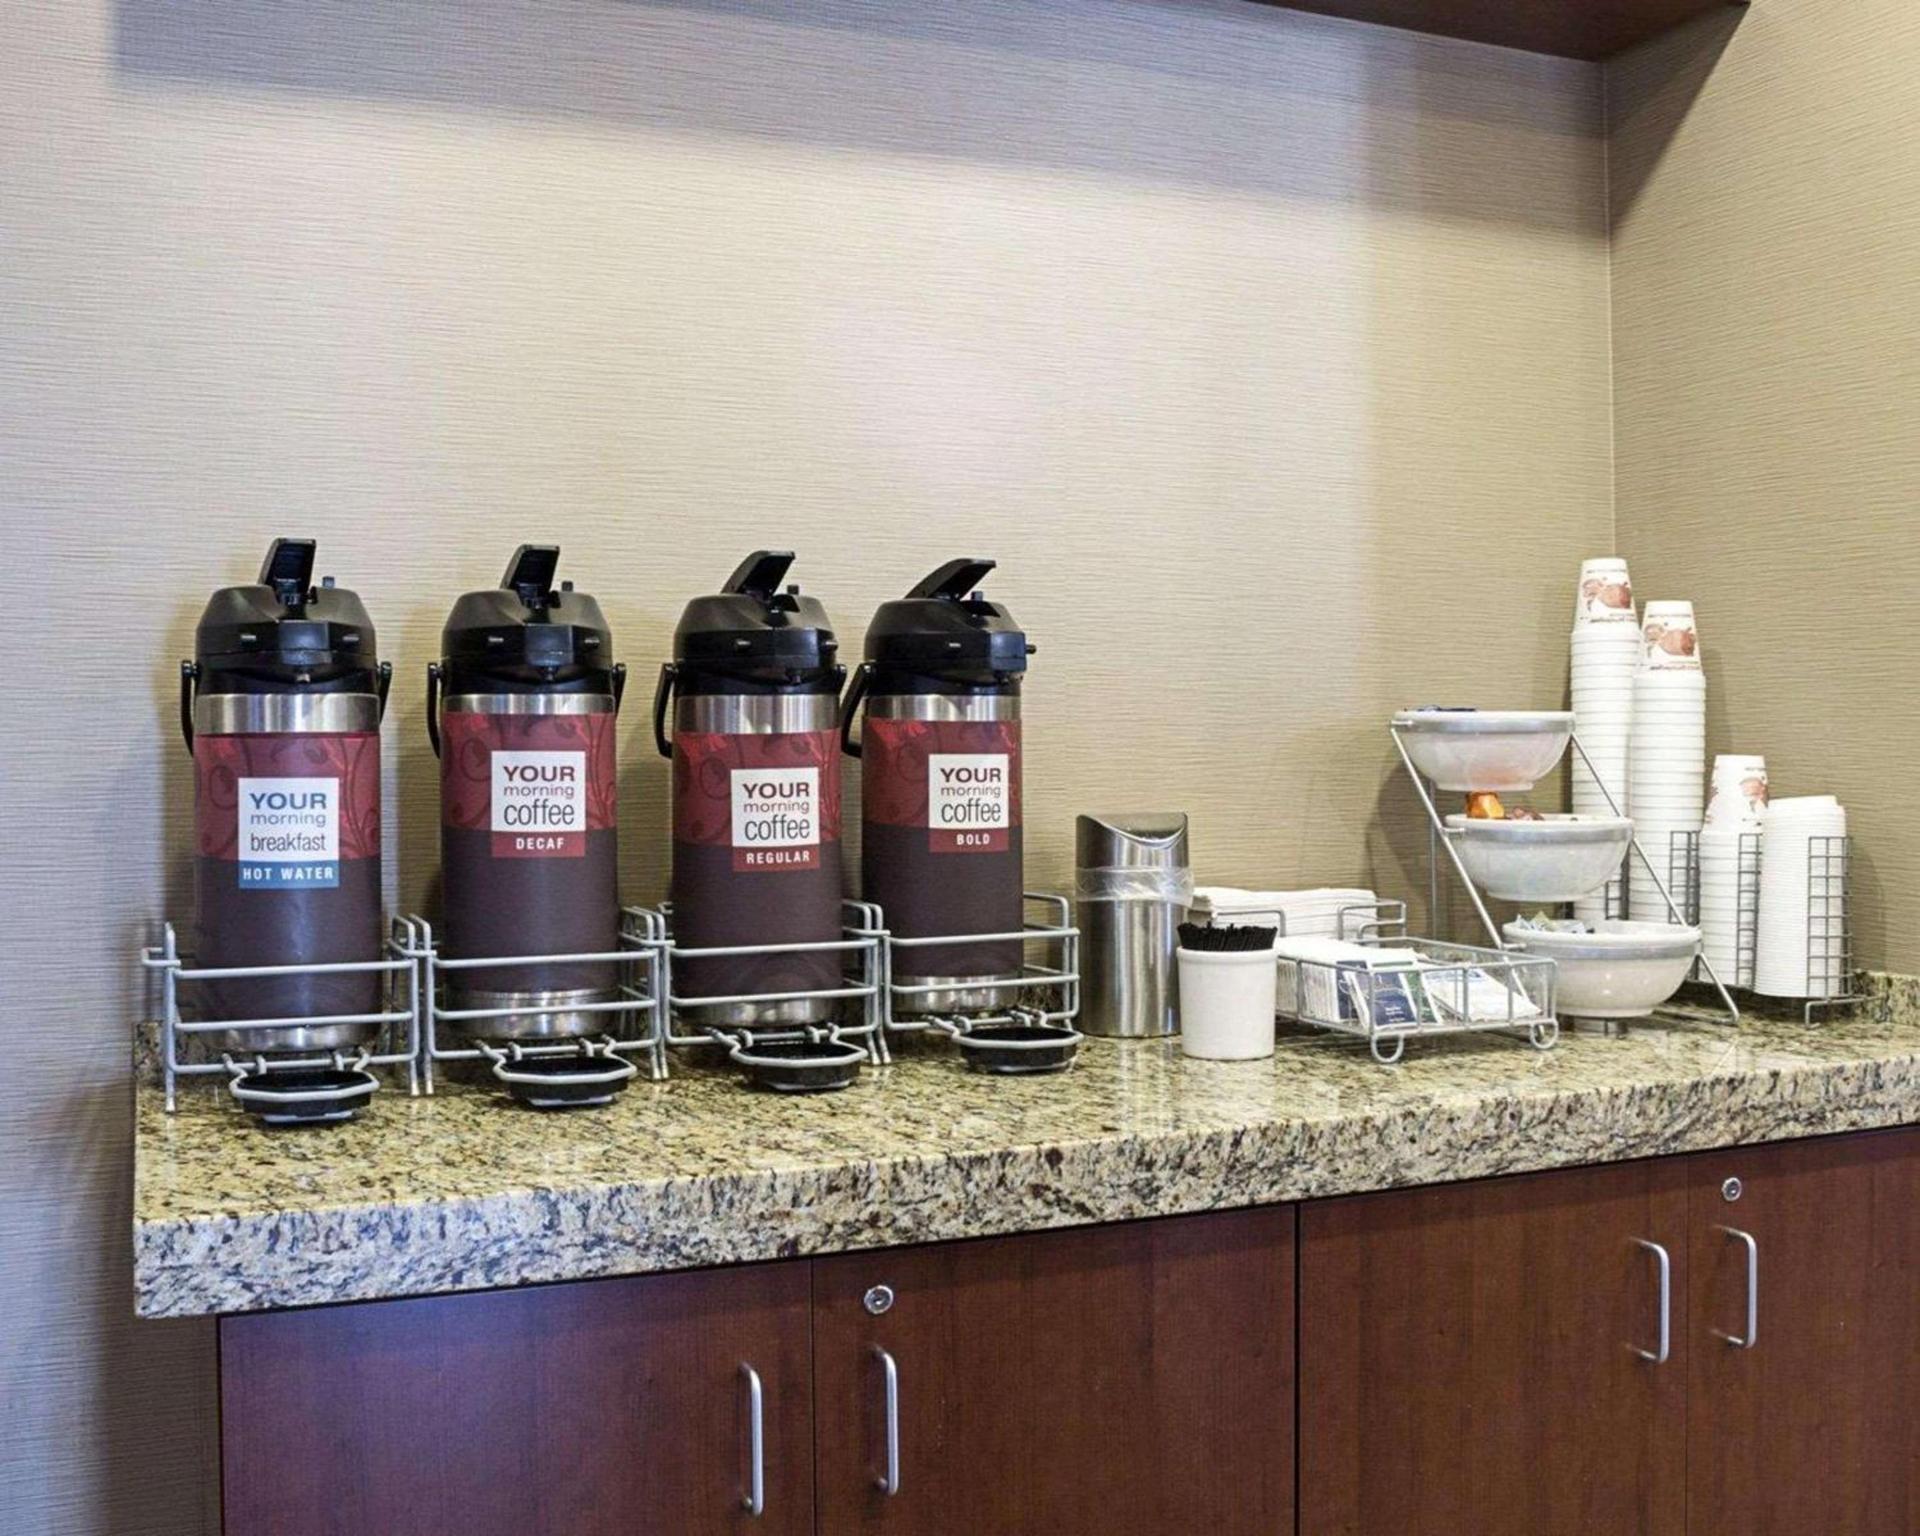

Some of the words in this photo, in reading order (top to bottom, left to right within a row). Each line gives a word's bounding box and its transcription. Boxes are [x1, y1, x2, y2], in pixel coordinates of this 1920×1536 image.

[504, 766, 575, 782] YOUR
[941, 767, 1001, 782] YOUR
[504, 784, 575, 799] morning
[743, 782, 810, 798] YOUR
[941, 786, 1001, 799] morning
[250, 792, 327, 810] YOUR
[744, 801, 810, 814] morning
[504, 799, 575, 825] coffee
[942, 799, 1001, 823] coffee
[251, 811, 327, 828] morning
[745, 814, 810, 841] coffee
[250, 832, 326, 852] breakfast
[516, 838, 565, 850] DECAF
[956, 834, 990, 846] BOLD
[746, 850, 811, 864] REGULAR
[243, 868, 272, 880] HOT
[281, 867, 333, 880] WATER
